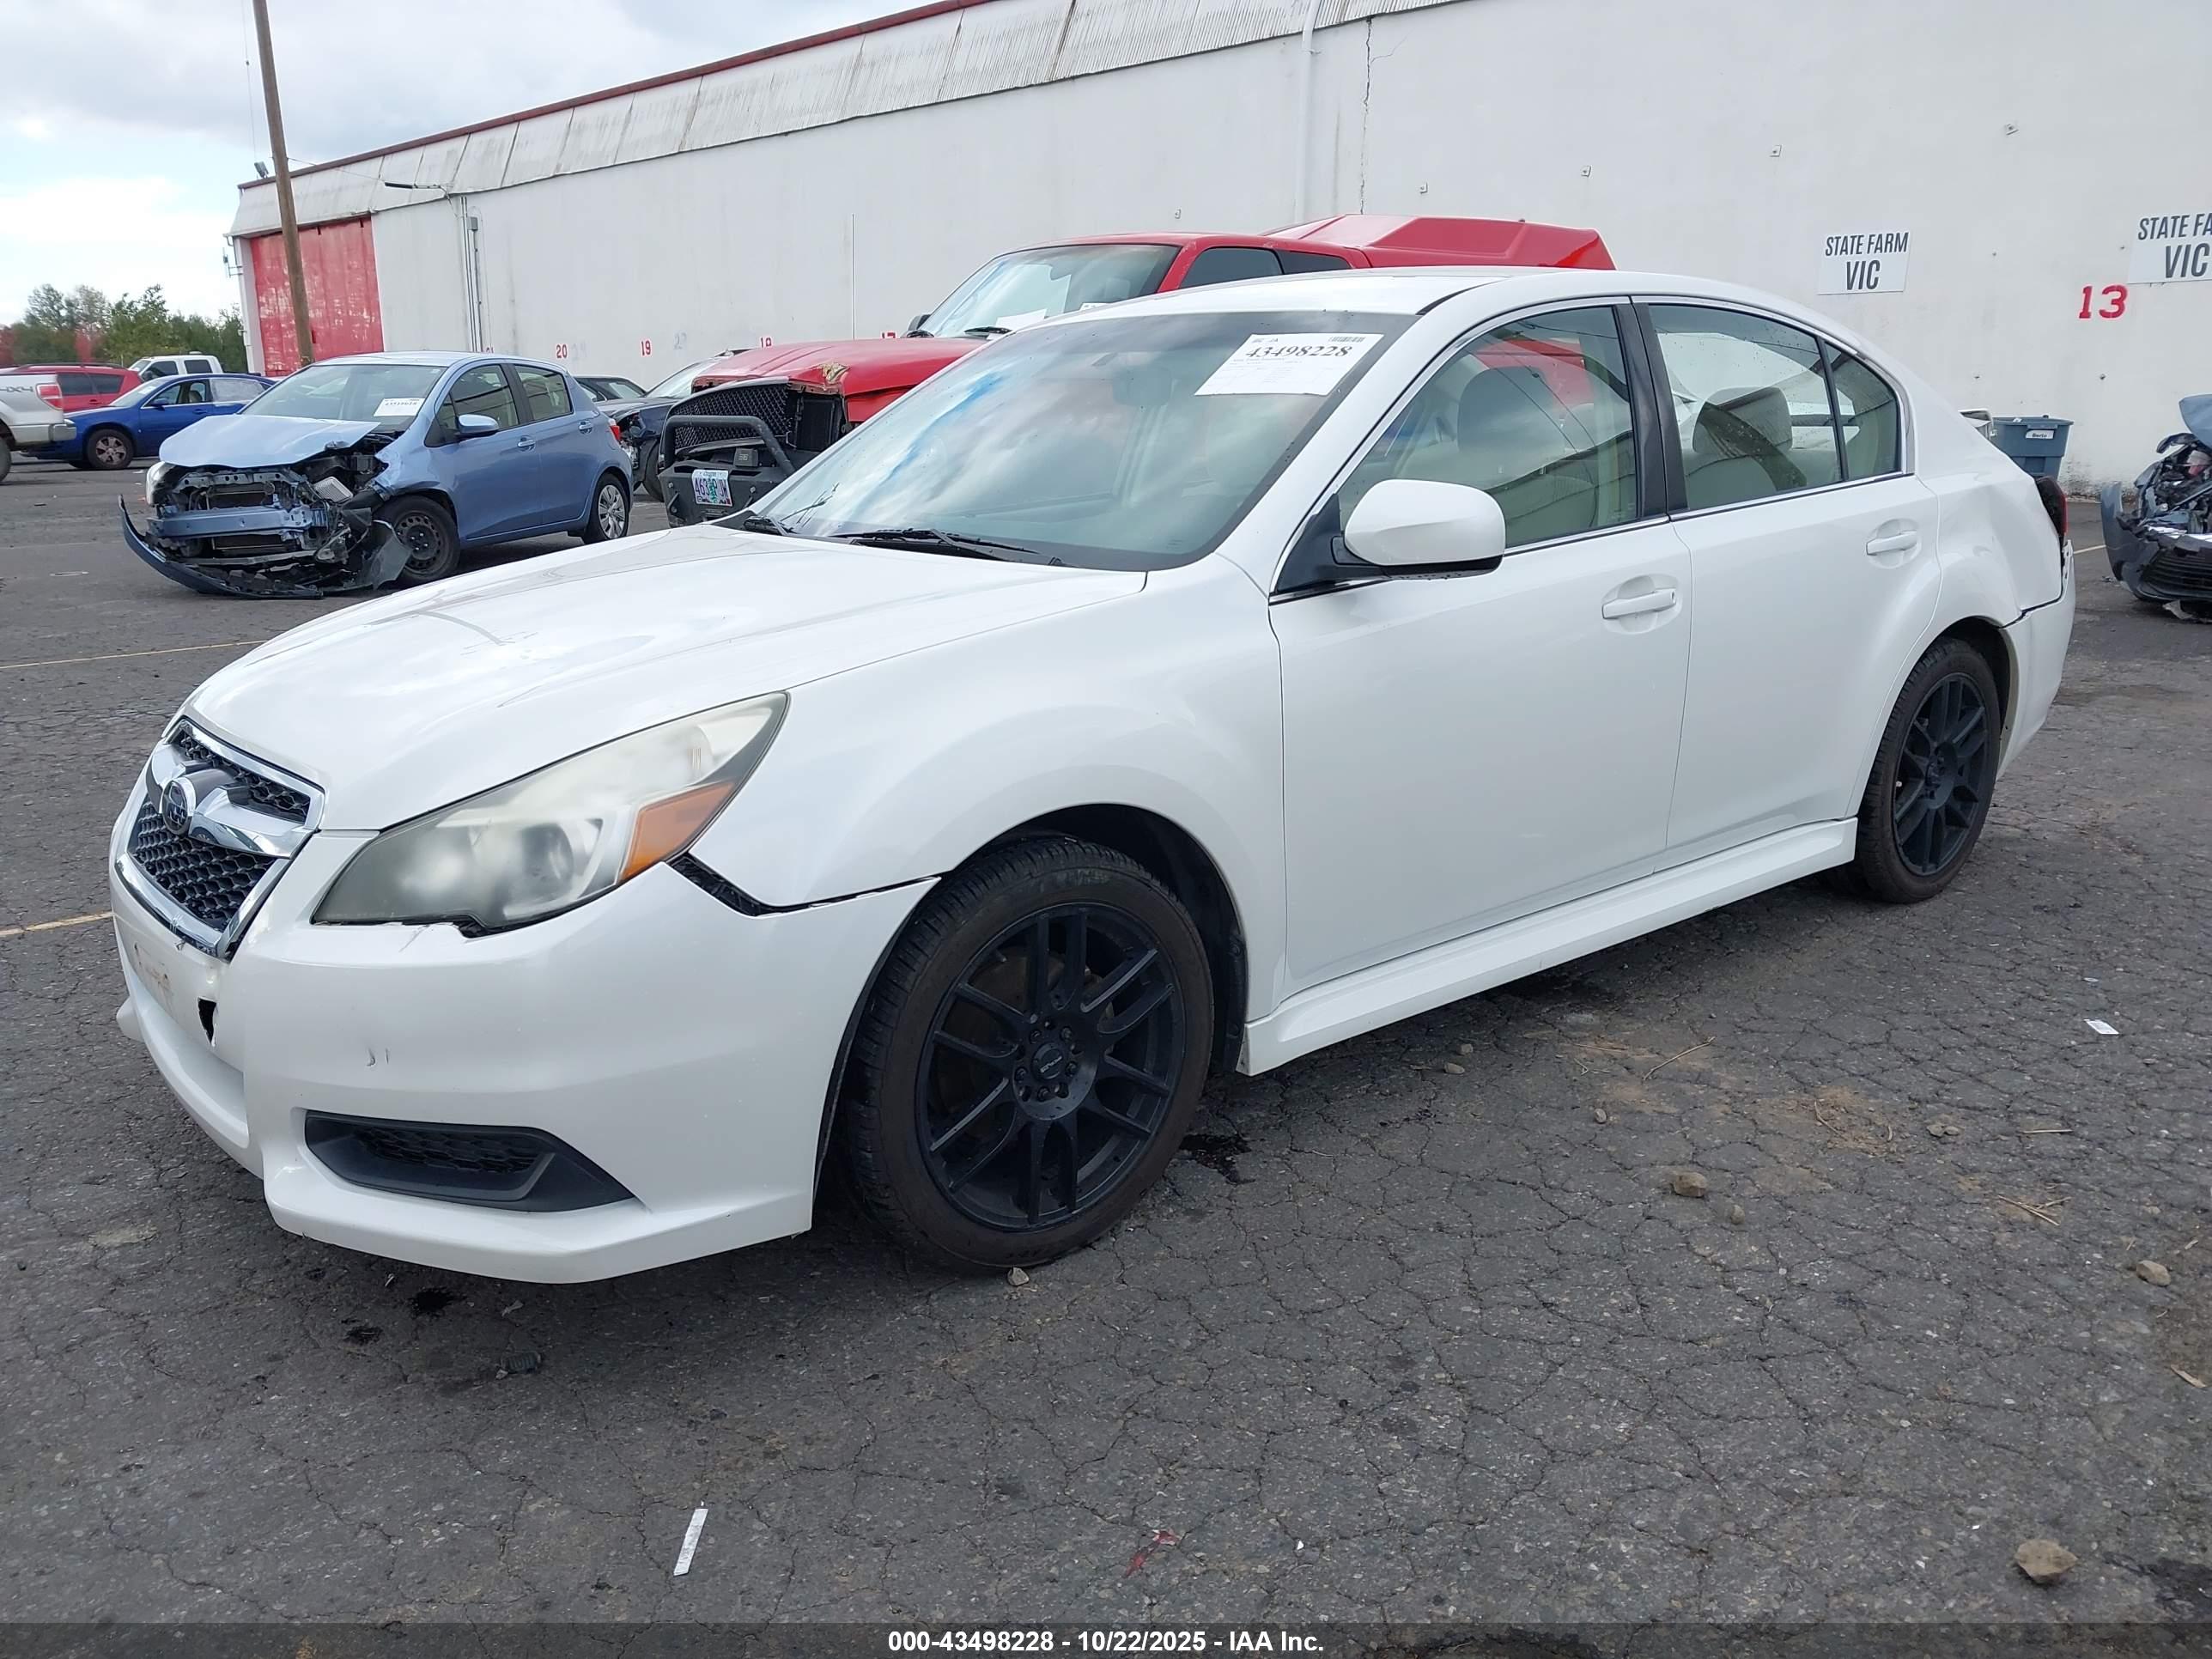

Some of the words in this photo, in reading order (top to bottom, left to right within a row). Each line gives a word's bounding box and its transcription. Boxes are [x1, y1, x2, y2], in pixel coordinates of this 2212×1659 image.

[2137, 214, 2191, 240] STATE
[1825, 234, 1864, 257] STATE
[1867, 232, 1909, 254] FARM
[2165, 242, 2210, 278] VIC
[1846, 259, 1881, 290] VIC
[2079, 284, 2128, 319] 13
[556, 343, 568, 359] 20
[641, 340, 652, 356] 19
[1246, 345, 1353, 358] 43498228
